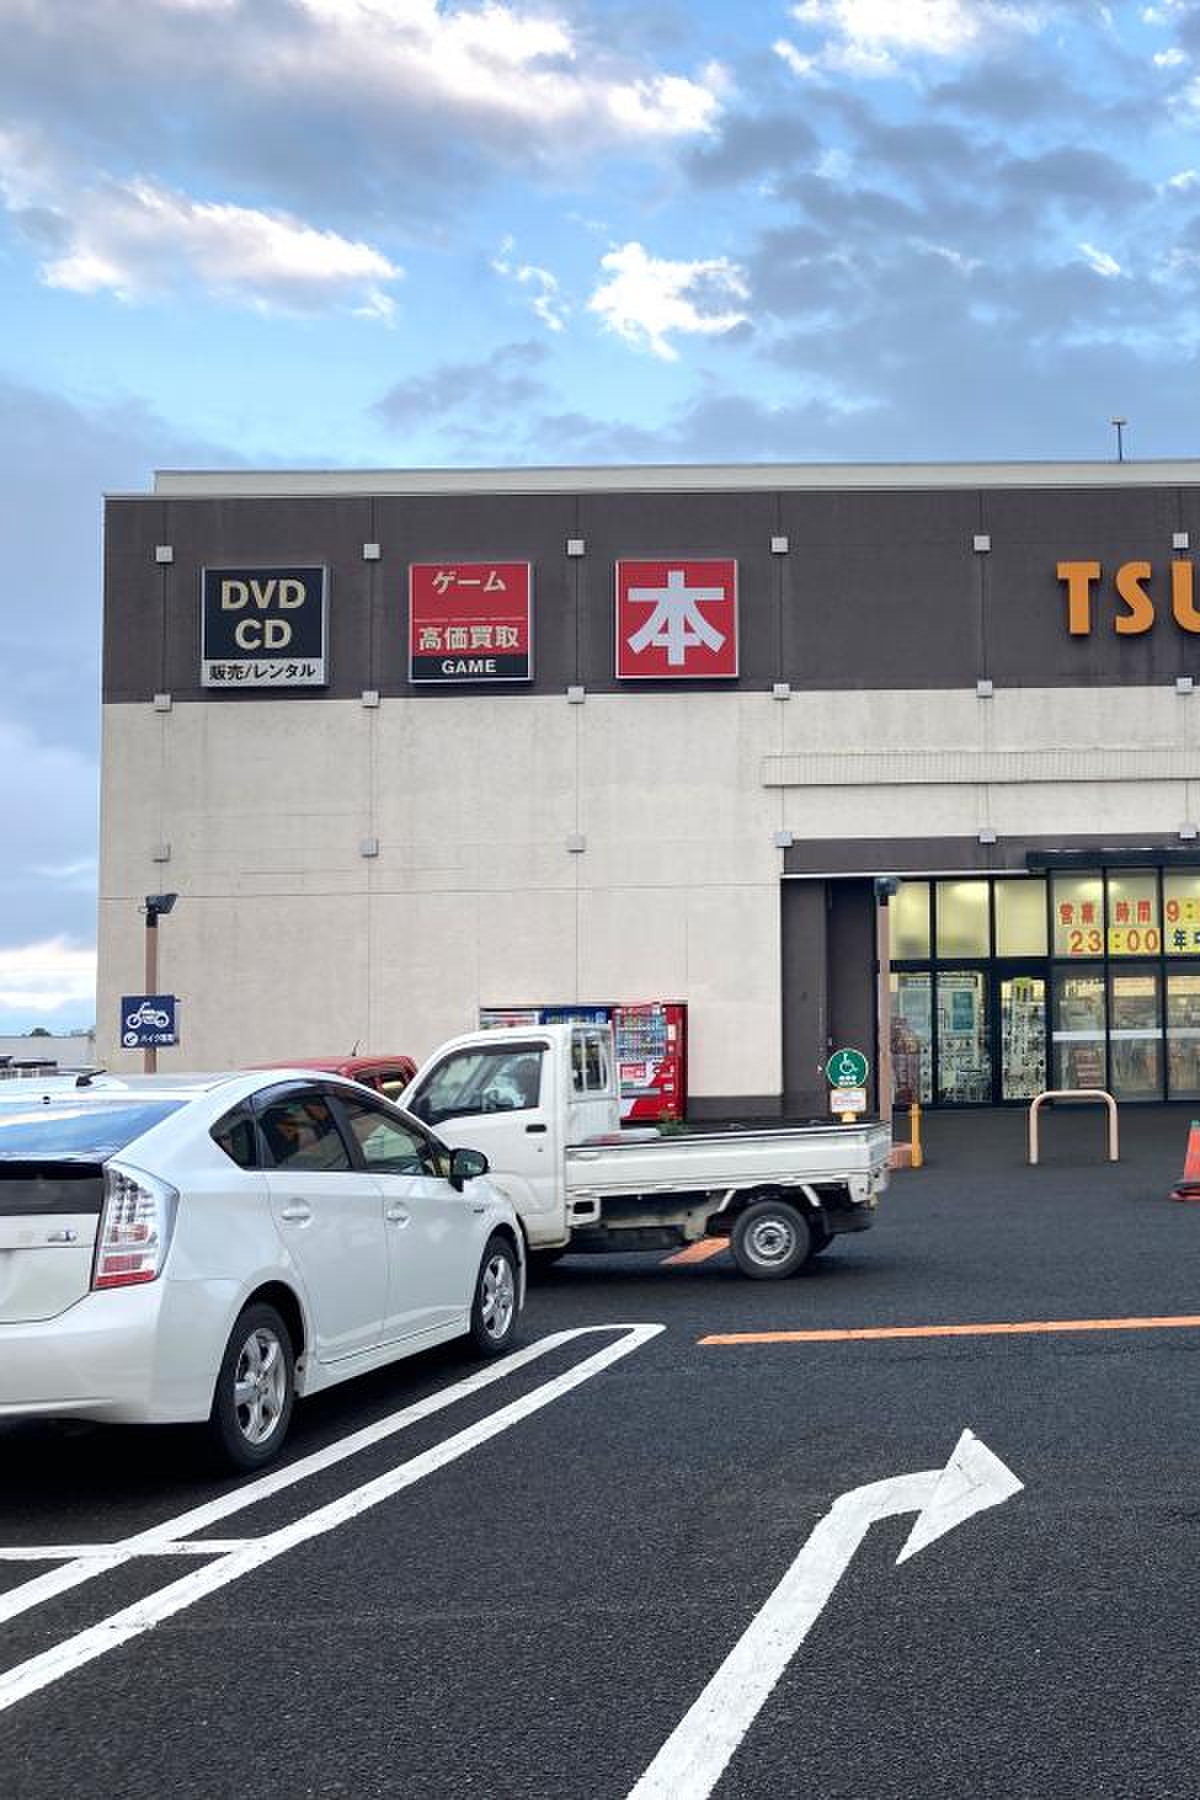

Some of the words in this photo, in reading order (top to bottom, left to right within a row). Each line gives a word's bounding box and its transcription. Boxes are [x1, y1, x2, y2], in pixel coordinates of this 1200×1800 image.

[221, 579, 306, 610] DVD
[431, 571, 507, 594] ゲーム
[626, 570, 726, 666] 本
[235, 618, 292, 650] CD
[419, 625, 519, 650] 高価買取
[209, 663, 316, 681] 販売/レンタル
[441, 659, 497, 674] GAME
[1069, 929, 1159, 953] 23:00
